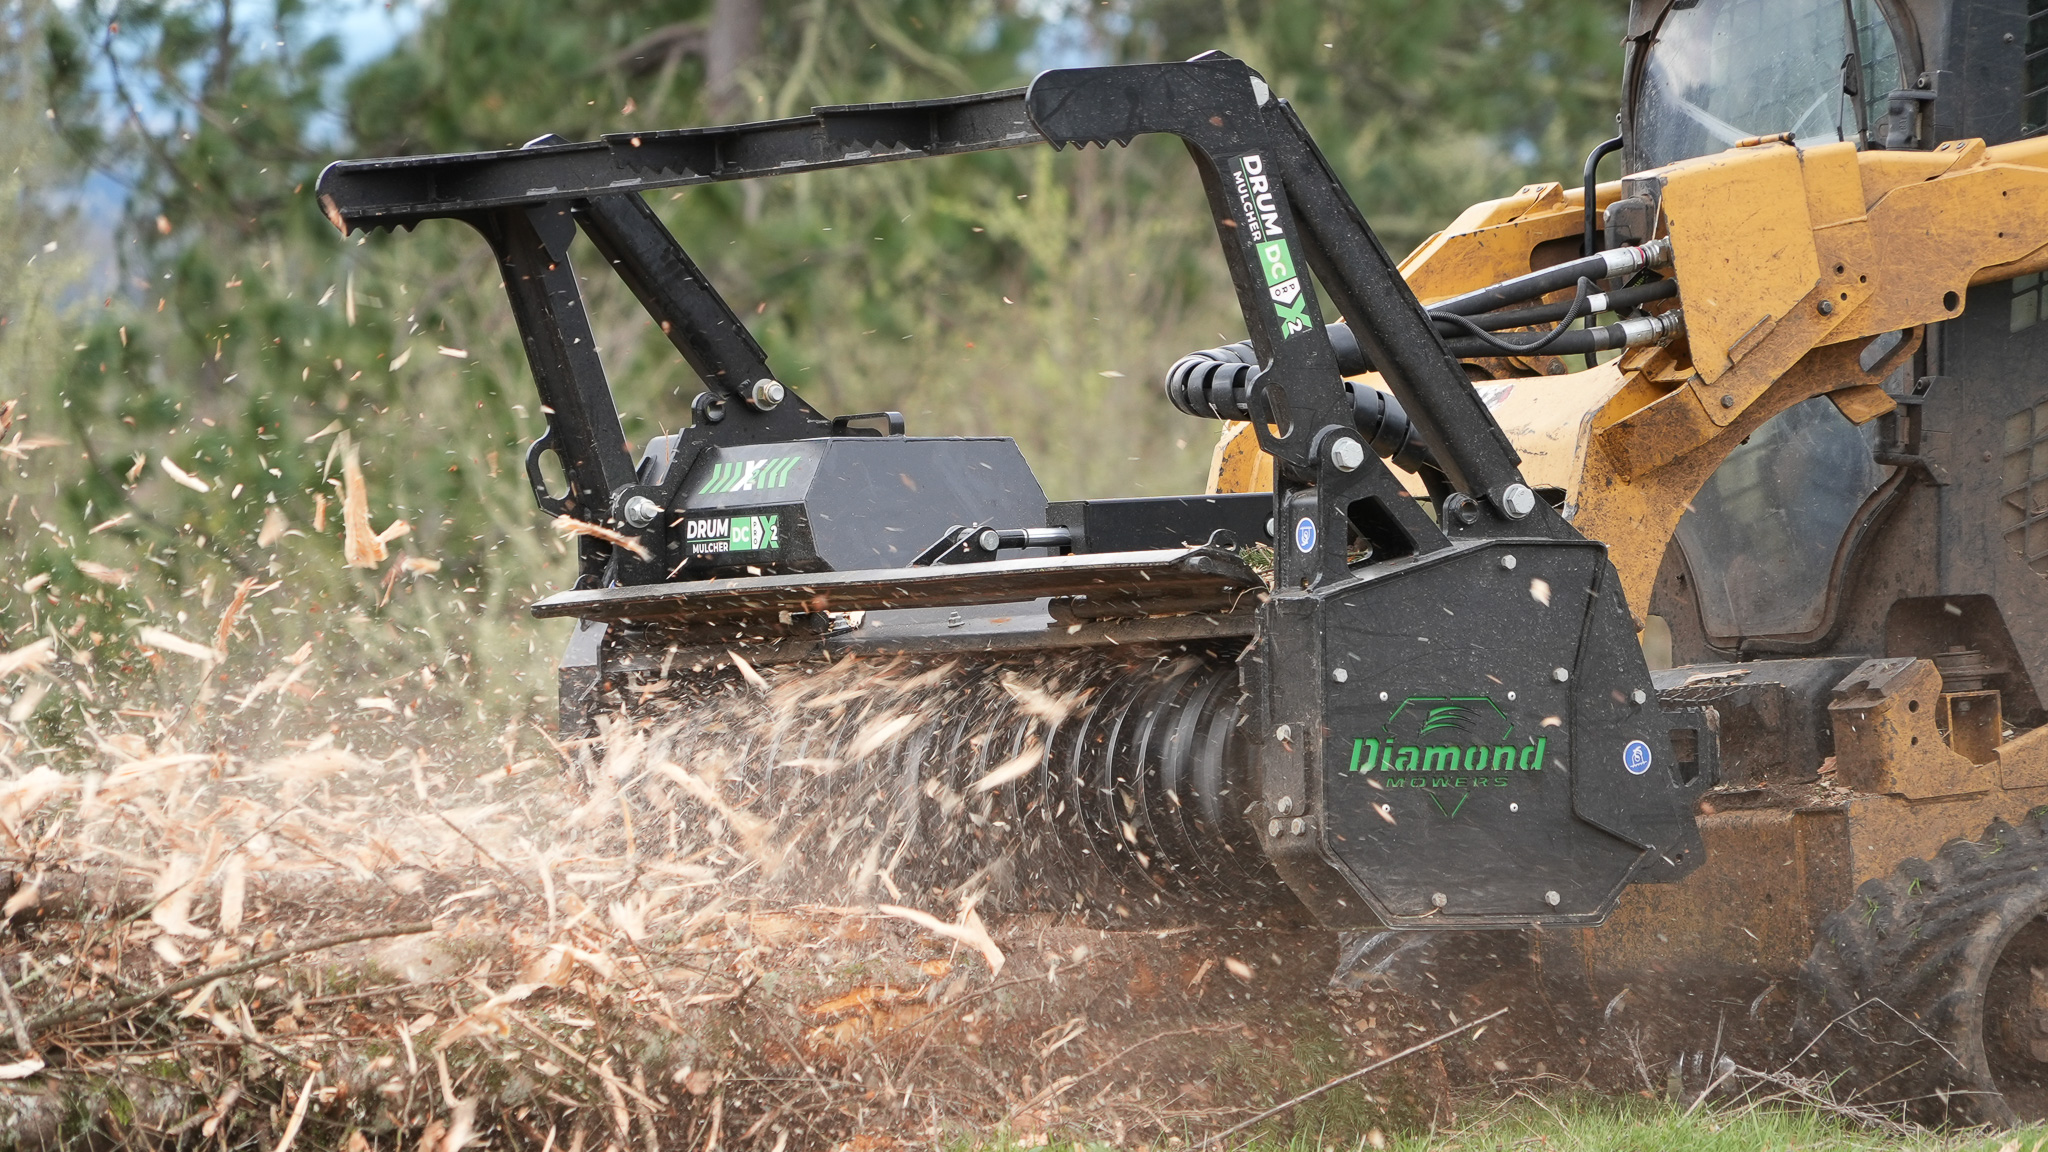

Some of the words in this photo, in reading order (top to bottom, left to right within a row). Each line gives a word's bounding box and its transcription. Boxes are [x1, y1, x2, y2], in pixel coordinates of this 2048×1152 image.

[1233, 170, 1262, 242] MULCHER
[1243, 154, 1283, 236] DRUM
[1264, 243, 1287, 280] DC
[1275, 283, 1296, 297] PRO
[686, 518, 729, 539] DRUM
[732, 526, 749, 543] DC
[692, 542, 729, 554] MULCHER
[1349, 736, 1547, 772] Diamond
[1386, 776, 1509, 788] MOWERS
